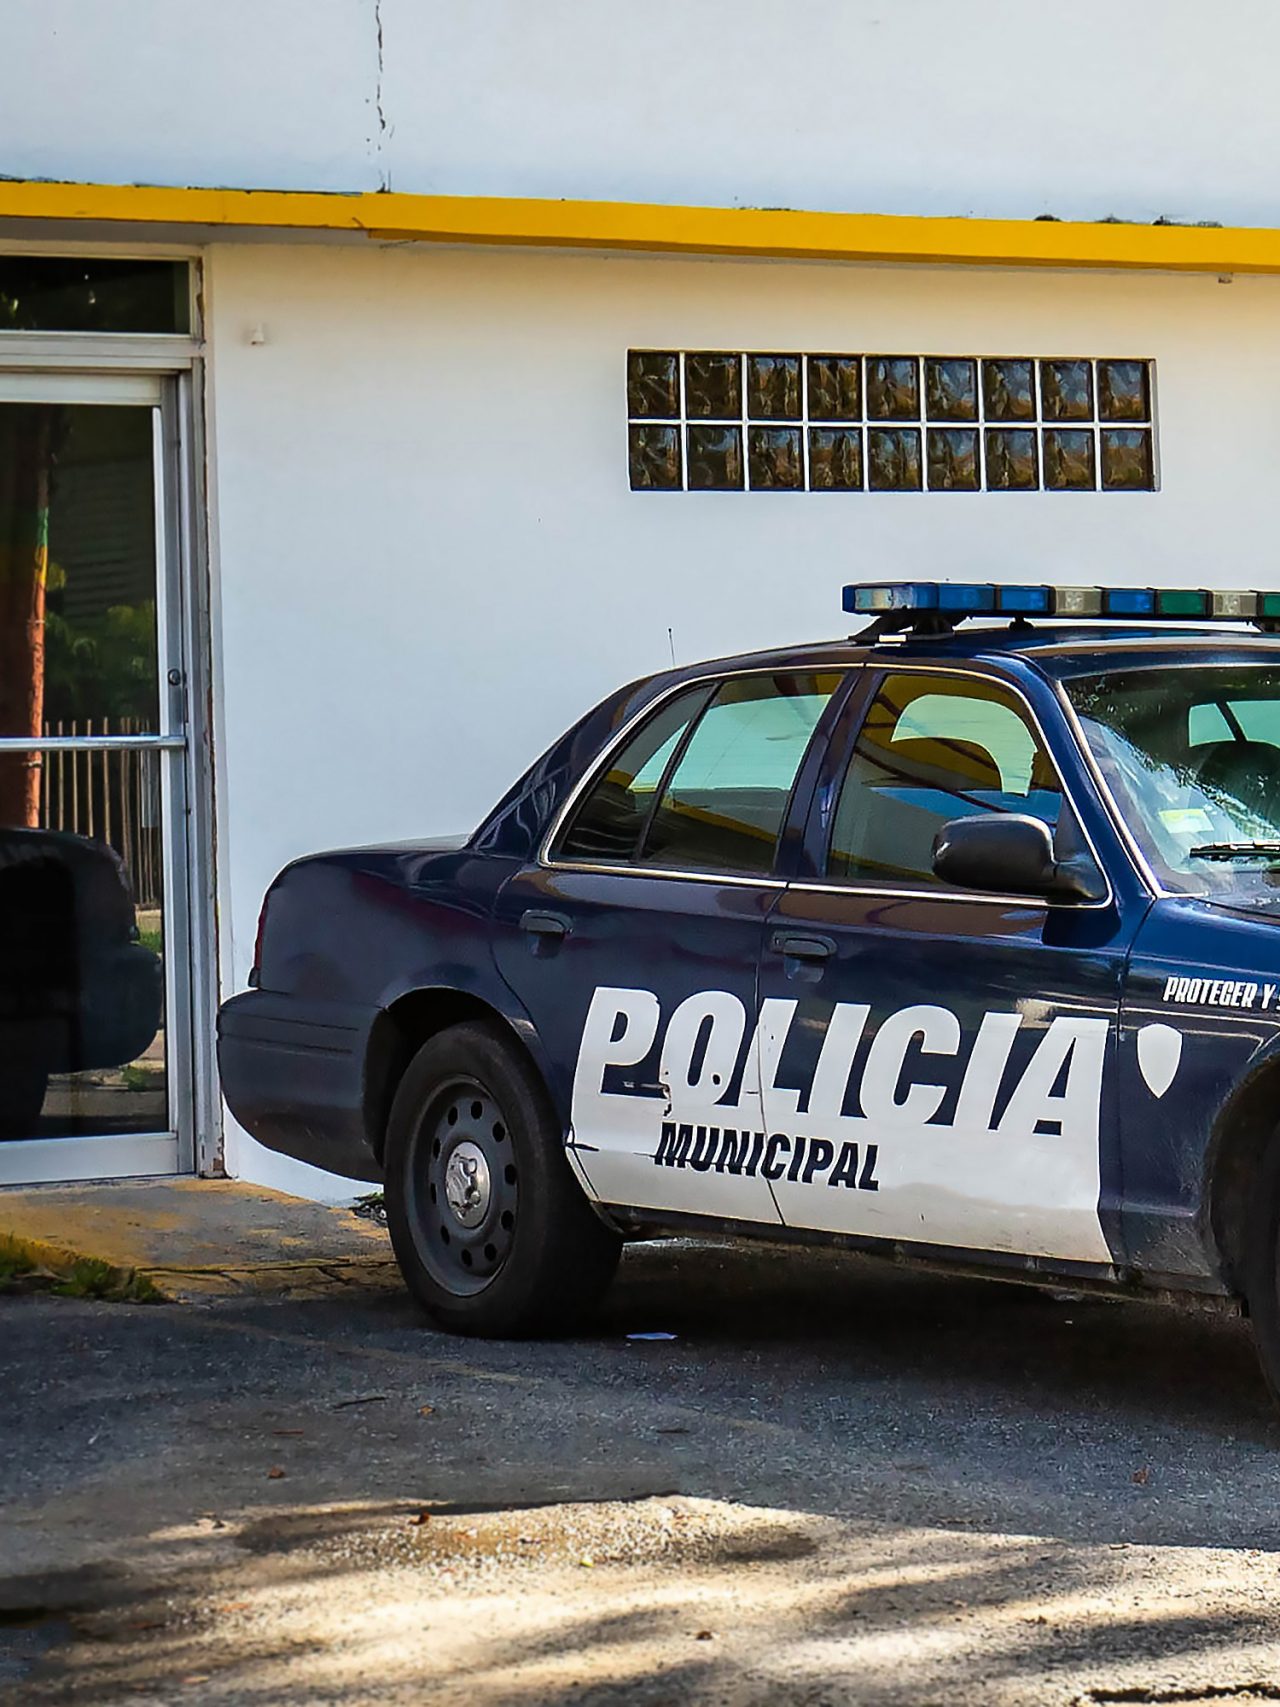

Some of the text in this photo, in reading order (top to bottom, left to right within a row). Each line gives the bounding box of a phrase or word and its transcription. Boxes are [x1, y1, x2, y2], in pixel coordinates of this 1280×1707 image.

[1162, 976, 1258, 1008] PROTEGER
[1261, 984, 1277, 1010] Y
[572, 986, 1110, 1137] POLICIA
[653, 1120, 880, 1192] MUNICIPAL
